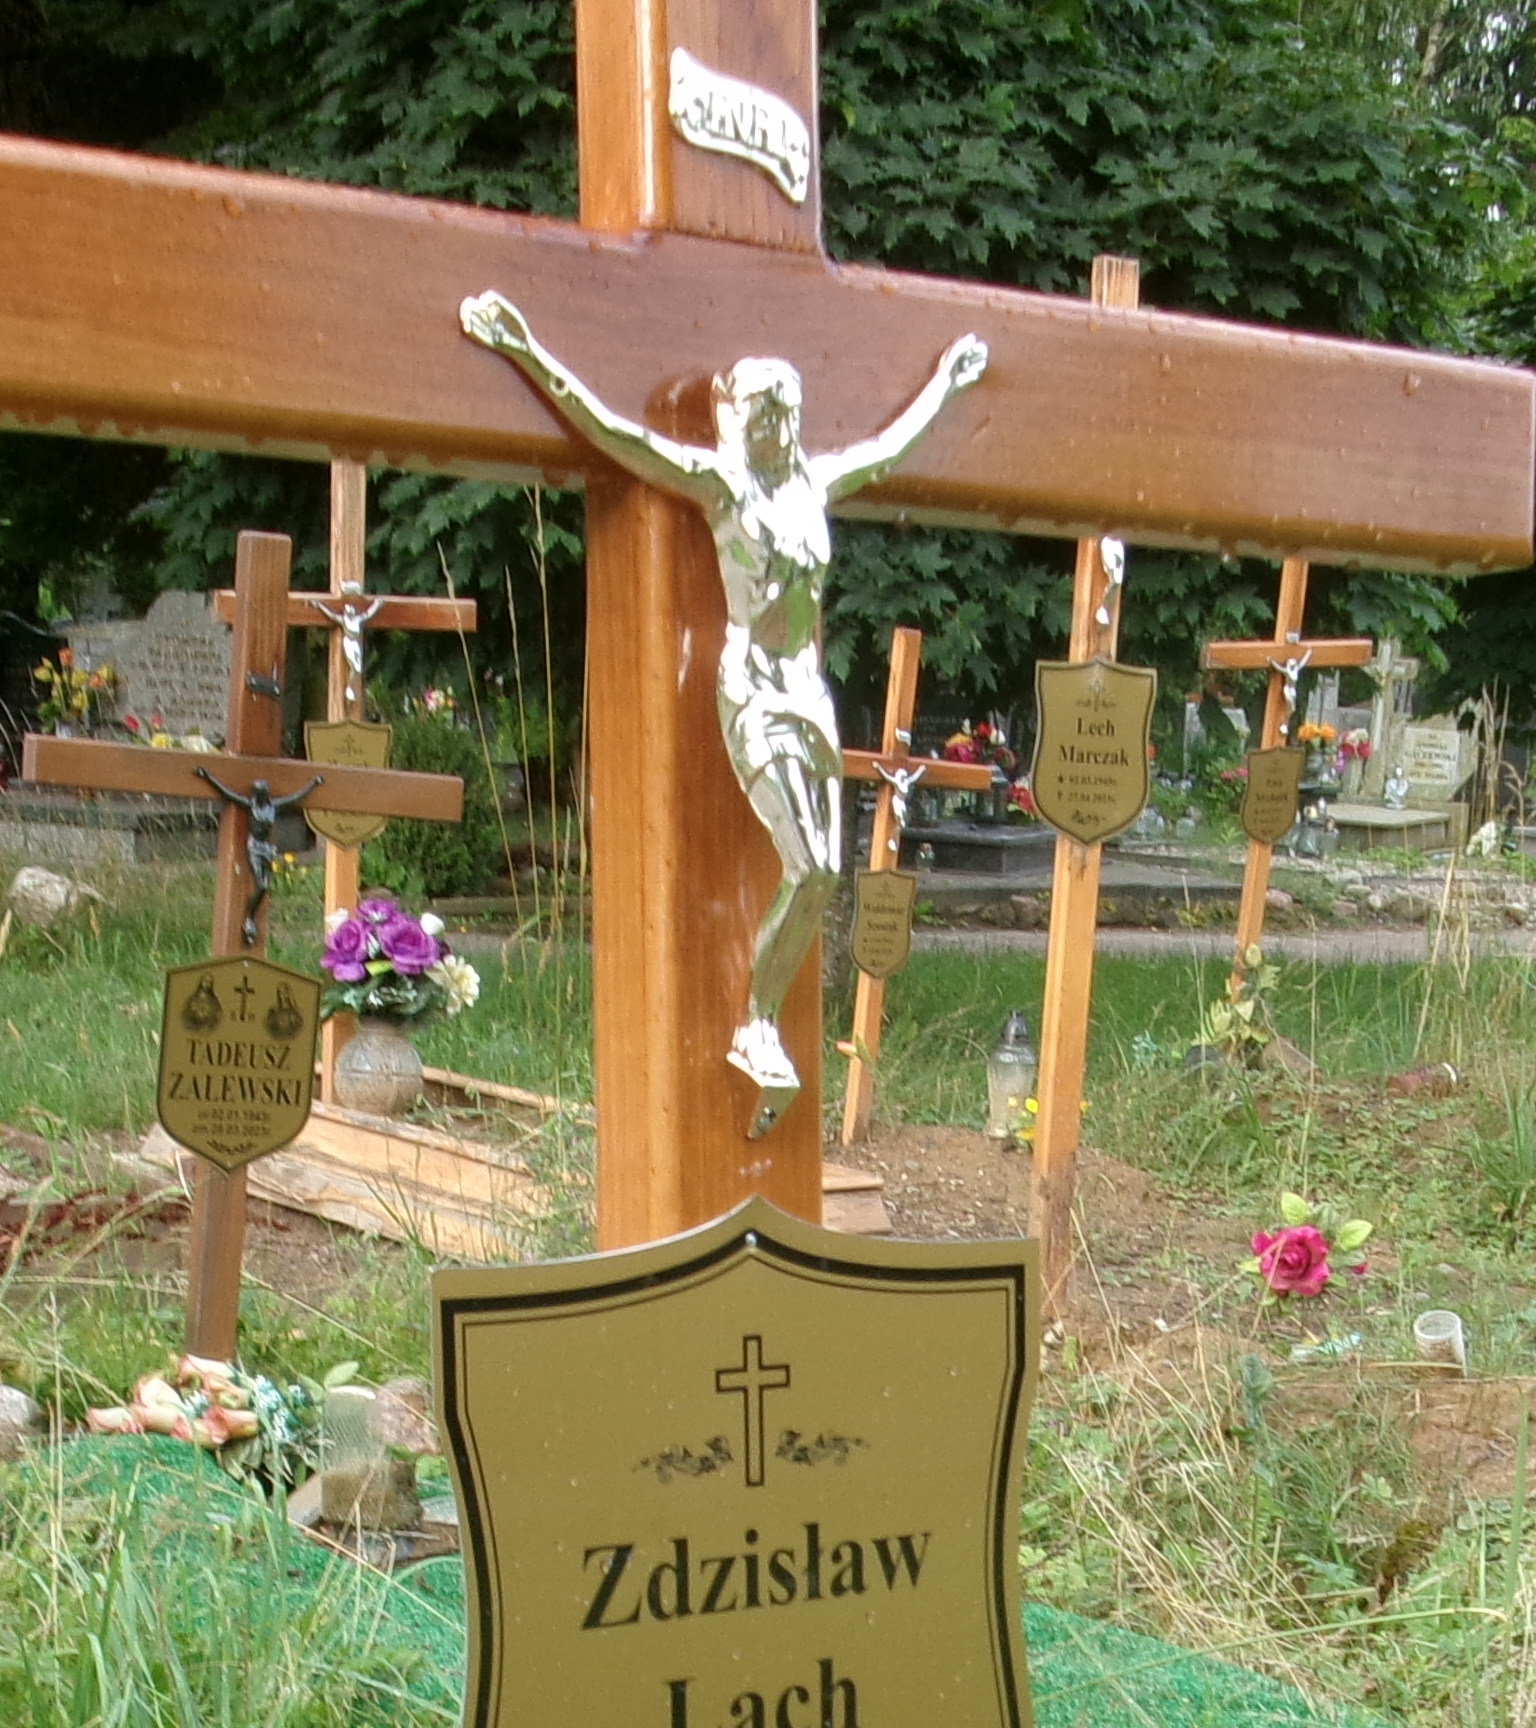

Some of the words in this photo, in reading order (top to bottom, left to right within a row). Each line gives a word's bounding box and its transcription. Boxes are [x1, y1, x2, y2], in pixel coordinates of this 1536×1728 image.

[1076, 716, 1116, 737] Lech
[1057, 743, 1129, 768] Marczak
[186, 1037, 293, 1072] TADEUSZ
[168, 1071, 302, 1107] ZALEWSKI
[581, 1521, 932, 1631] Zdzisław
